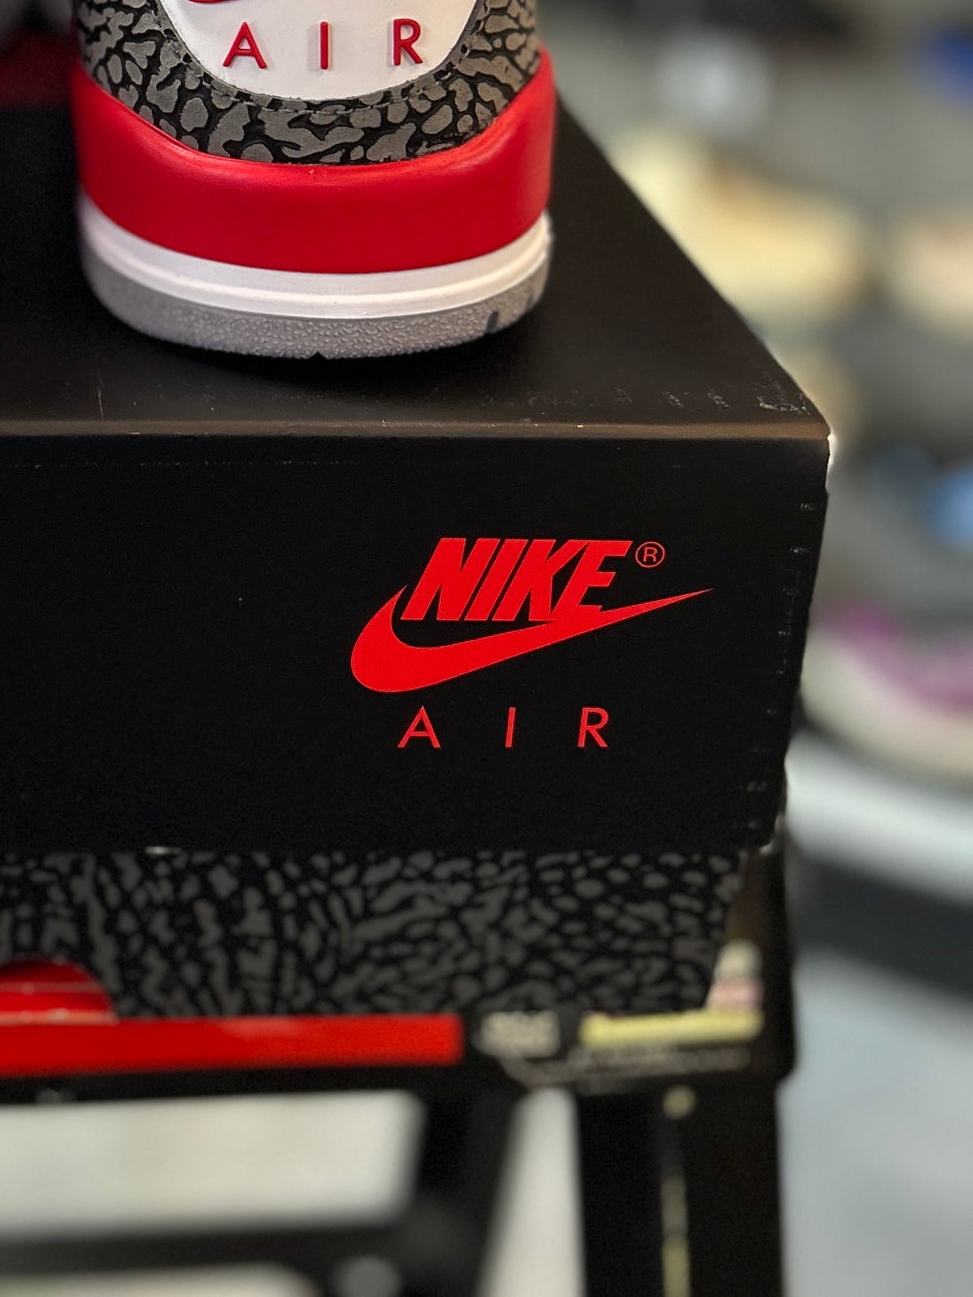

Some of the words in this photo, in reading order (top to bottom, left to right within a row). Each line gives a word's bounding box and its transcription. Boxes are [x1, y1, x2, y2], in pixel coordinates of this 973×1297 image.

[222, 18, 424, 70] AIR
[400, 537, 633, 622] NIKE
[397, 705, 610, 749] AIR
